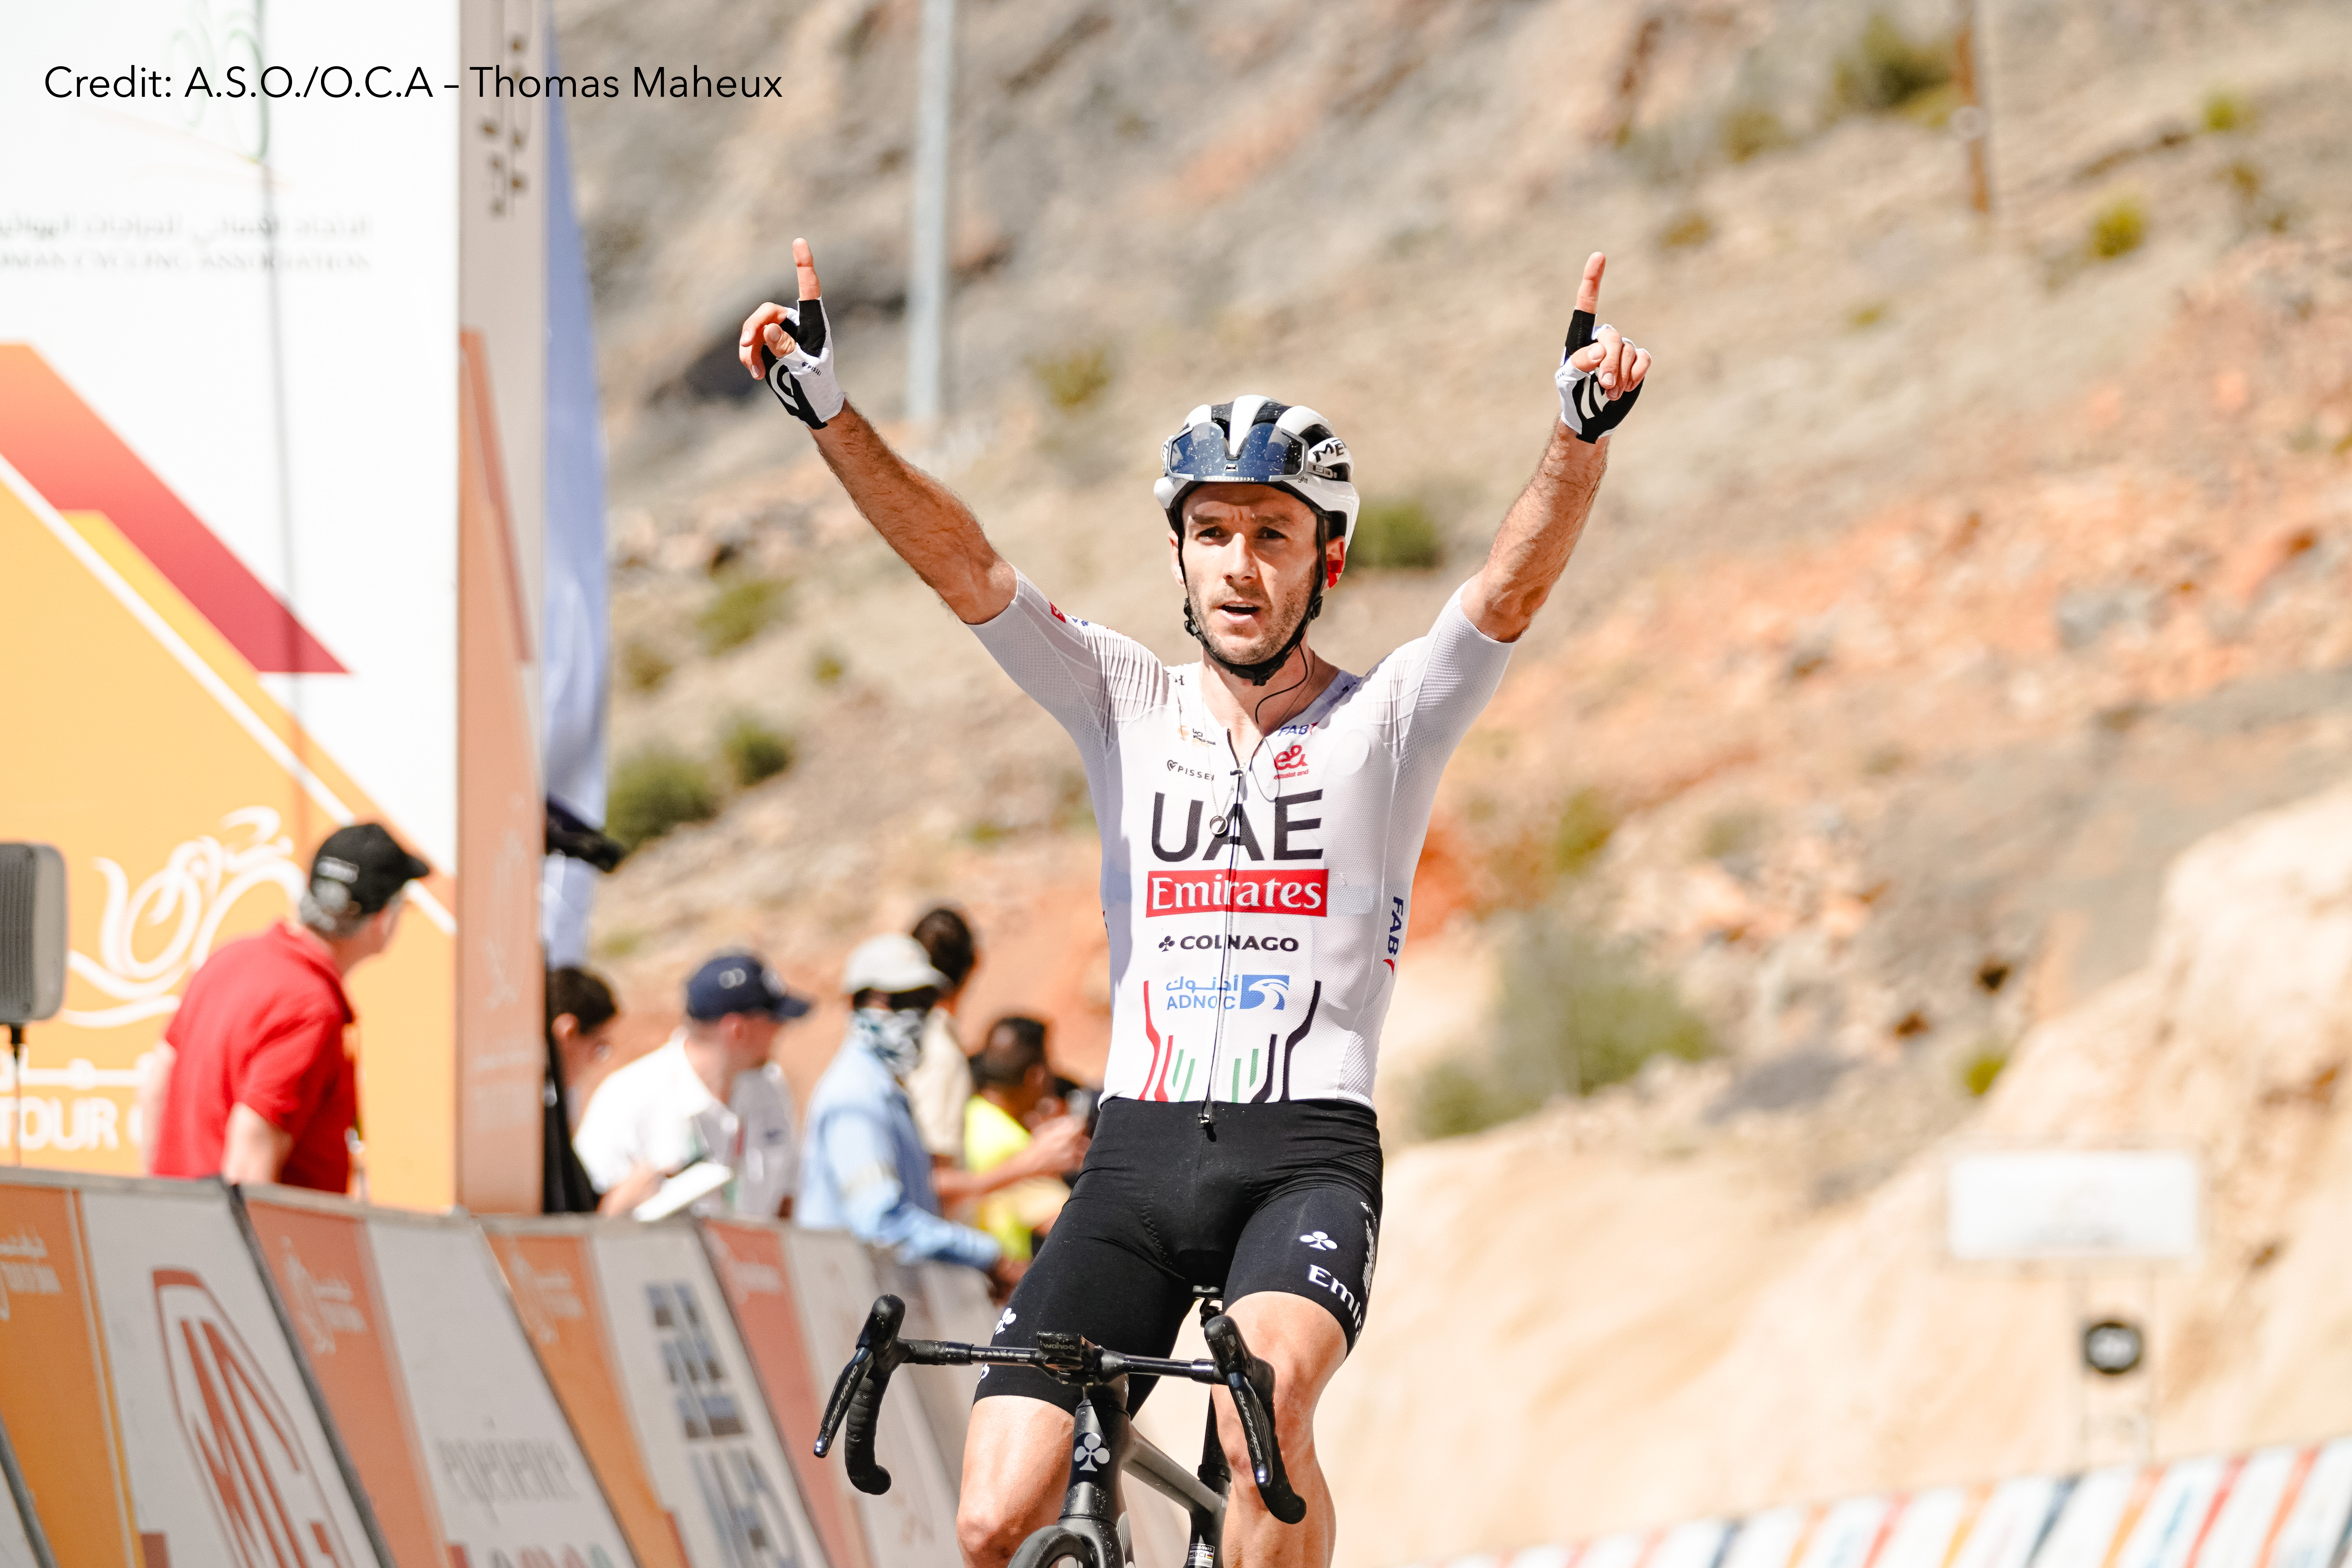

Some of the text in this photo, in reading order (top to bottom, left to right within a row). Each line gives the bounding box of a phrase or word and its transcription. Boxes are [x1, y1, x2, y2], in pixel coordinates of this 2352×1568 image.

[807, 365, 822, 376] PISSEI
[1277, 724, 1309, 737] FAB
[1151, 788, 1324, 862] UAE
[1151, 873, 1322, 911] Emirates
[1180, 935, 1299, 952] COLNAGO
[1388, 896, 1404, 955] FAB
[1167, 994, 1236, 1011] ADNOC
[827, 1364, 859, 1431] DURA-ACE
[1237, 1390, 1263, 1461] DURA-ACE
